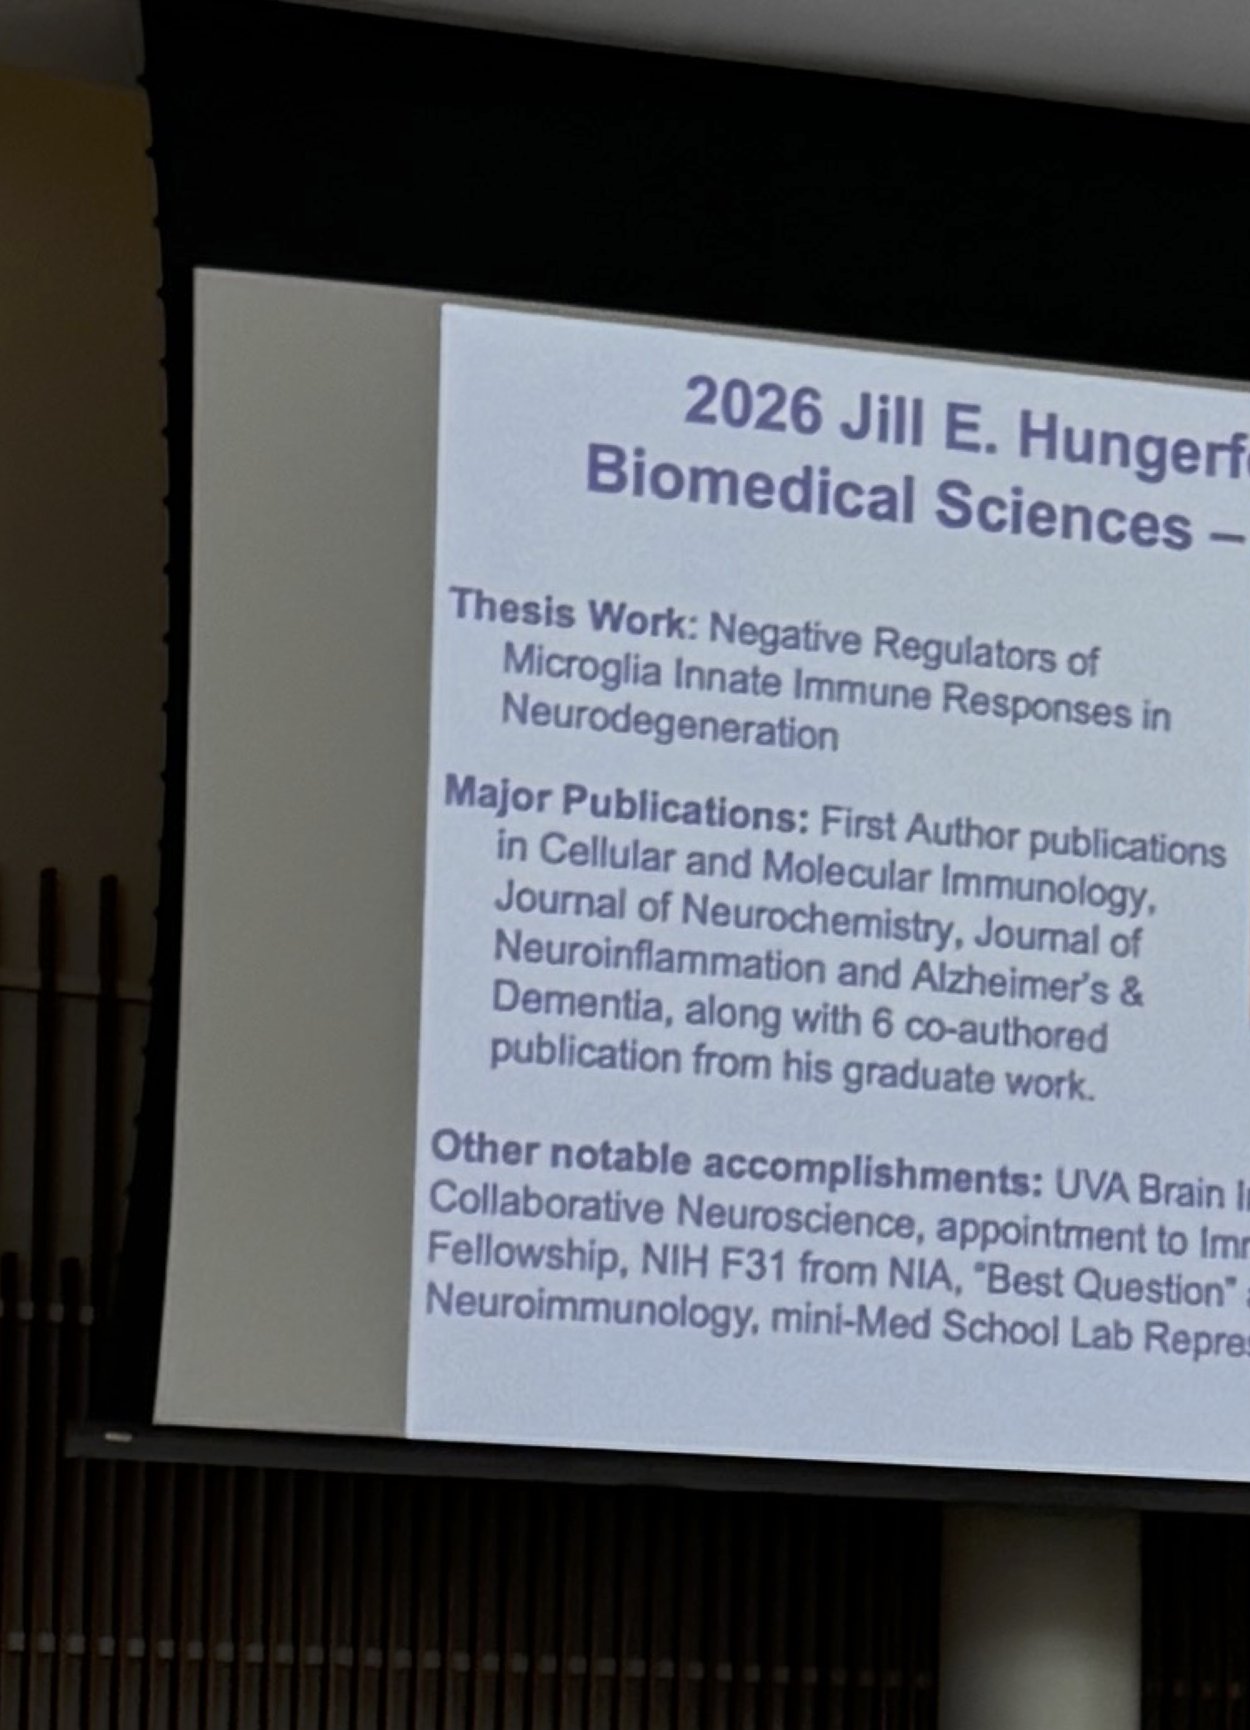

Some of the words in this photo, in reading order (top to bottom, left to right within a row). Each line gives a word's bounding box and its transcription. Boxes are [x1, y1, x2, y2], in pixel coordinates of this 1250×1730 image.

[684, 373, 824, 436] 2026
[838, 390, 924, 448] Jill
[944, 400, 998, 455] E.
[586, 441, 916, 525] Biomedical
[934, 478, 1194, 552] Sciences
[448, 585, 577, 630] Thesis
[587, 598, 698, 641] Work:
[709, 609, 863, 657] Negative
[873, 625, 1058, 674] Regulators
[1066, 645, 1102, 678] of
[501, 690, 840, 753] Neurodegeneration
[503, 640, 663, 693] Microglia
[673, 655, 783, 698] Innate
[793, 666, 933, 711] Immune
[942, 680, 1133, 729] Responses
[1141, 698, 1172, 733] in
[444, 772, 554, 819] Major
[561, 782, 810, 836] Publications:
[820, 803, 898, 843] First
[904, 811, 1022, 852] Author
[1028, 825, 1228, 869] publications
[496, 827, 529, 863] in
[538, 830, 678, 874] Cellular
[684, 846, 753, 880] and
[762, 847, 933, 894] Molecular
[941, 861, 1157, 919] Immunology,
[493, 877, 627, 920] Journal
[637, 889, 674, 923] of
[681, 891, 964, 953] Neurochemistry,
[973, 914, 1101, 956] Journal
[1109, 925, 1144, 959] of
[493, 927, 827, 985] Neuroinflammation
[836, 956, 902, 991] and
[909, 958, 1110, 1006] Alzheimer's
[1118, 974, 1145, 1008] &
[492, 977, 674, 1029] Dementia,
[684, 992, 783, 1040] along
[791, 1000, 863, 1037] with
[871, 1004, 895, 1040] 6
[903, 1014, 1109, 1054] co-authored
[489, 1030, 682, 1075] publication
[691, 1040, 772, 1080] from
[782, 1047, 833, 1085] his
[841, 1056, 996, 1096] graduate
[1004, 1068, 1095, 1102] work.
[431, 1127, 542, 1167] Other
[549, 1139, 693, 1177] notable
[702, 1152, 1043, 1199] accomplishments:
[1055, 1166, 1131, 1204] UVA
[1138, 1171, 1226, 1210] Brain
[429, 1177, 665, 1226] Collaborative
[676, 1192, 926, 1246] Neuroscience,
[935, 1213, 1148, 1255] appointment
[1156, 1223, 1189, 1257] to
[427, 1229, 629, 1282] Fellowship,
[640, 1240, 710, 1280] NIH
[720, 1244, 785, 1283] F31
[797, 1248, 878, 1289] from
[888, 1254, 964, 1298] NIA,
[426, 1280, 760, 1340] Neuroimmunology,
[770, 1299, 933, 1340] mini-Med
[941, 1306, 1060, 1348] School
[1070, 1314, 1135, 1352] Lab
